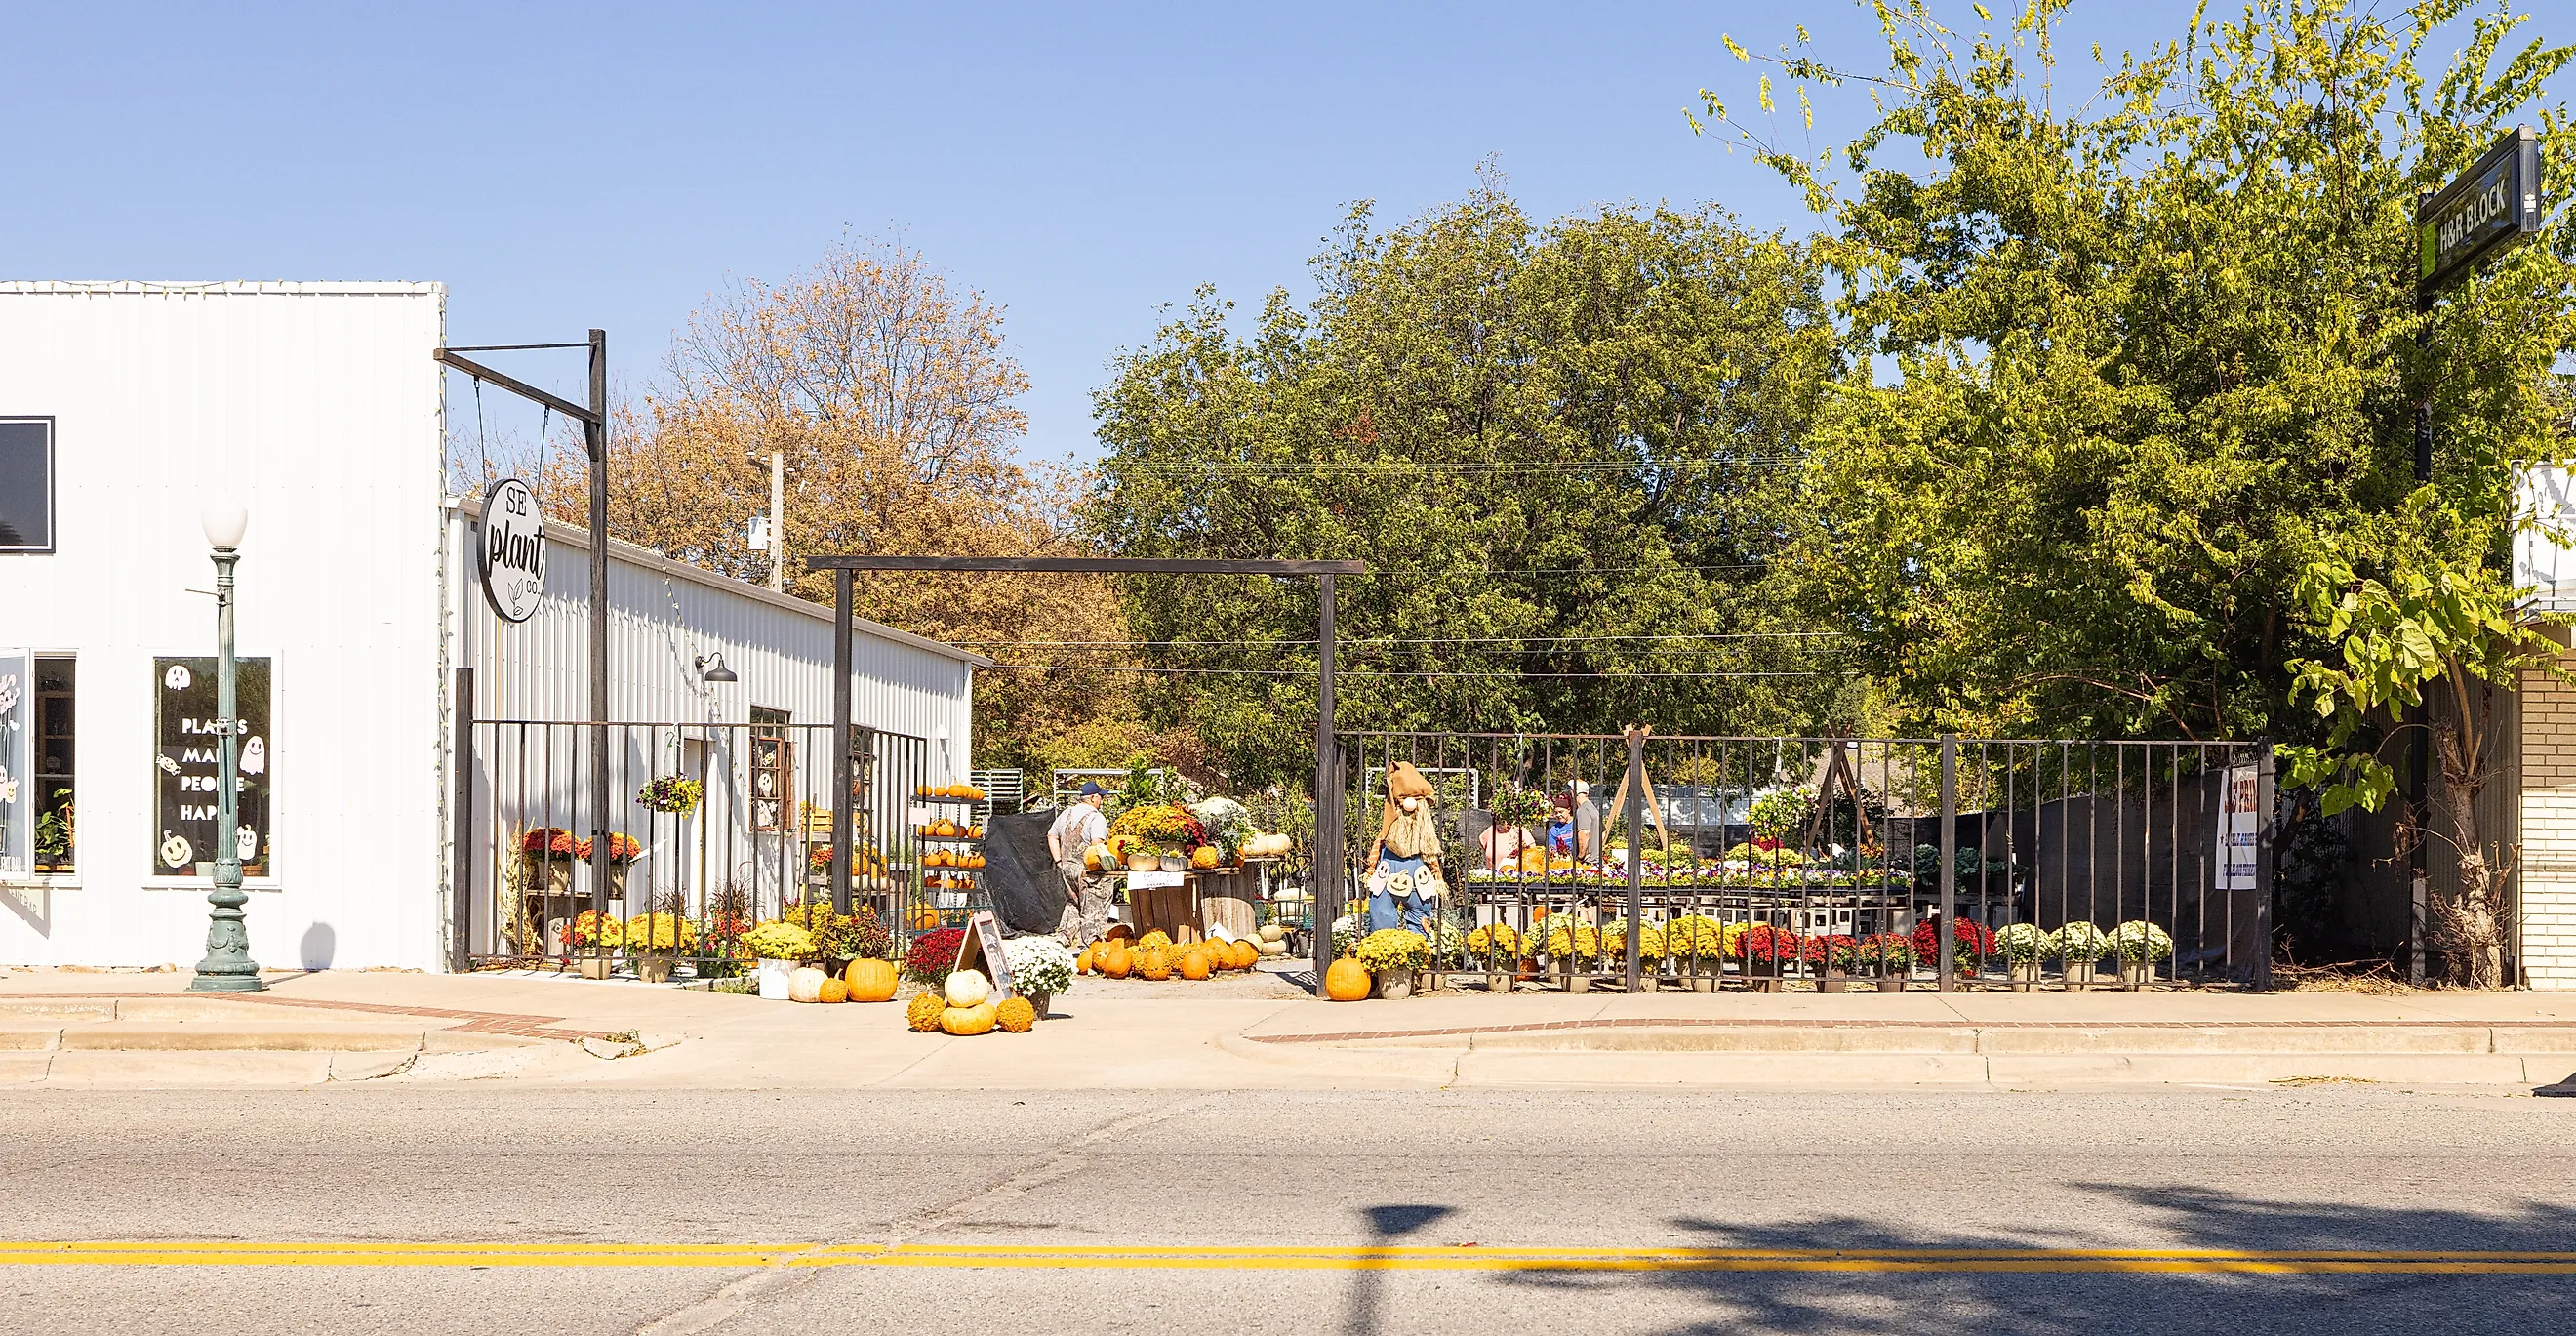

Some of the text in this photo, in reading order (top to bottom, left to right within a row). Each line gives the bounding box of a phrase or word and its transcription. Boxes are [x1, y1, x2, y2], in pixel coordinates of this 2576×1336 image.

[2439, 179, 2506, 254] H&R BLOCK
[506, 487, 527, 516] SE
[489, 519, 546, 581] plant
[182, 718, 248, 734] PLAS
[181, 748, 219, 763] MA
[181, 776, 244, 791] PEOE
[181, 804, 239, 821] HAP
